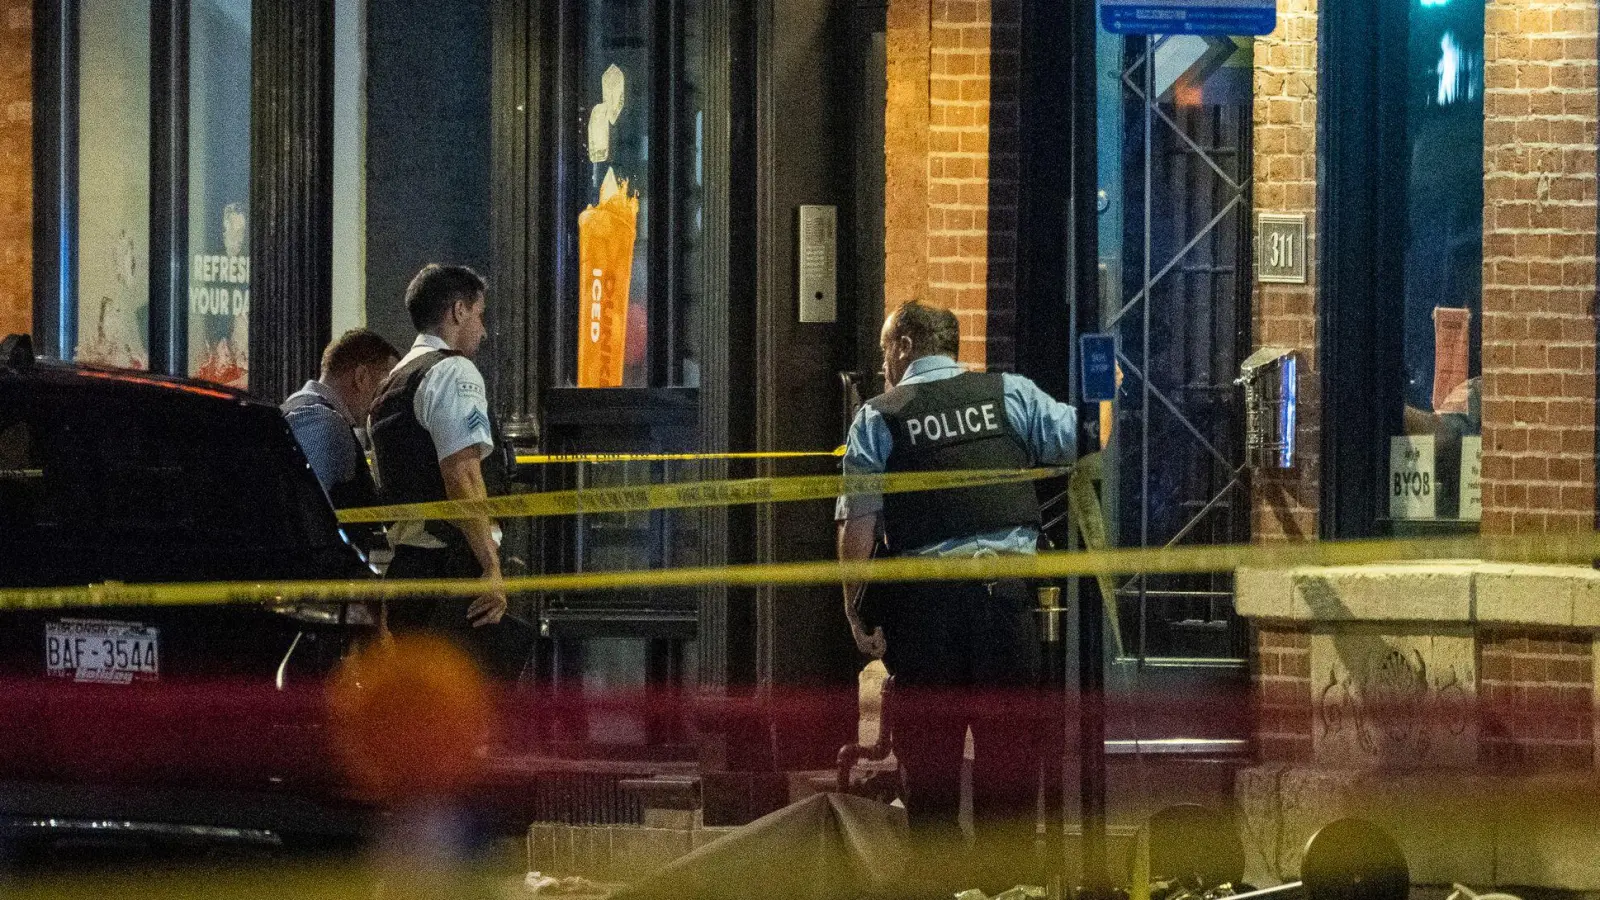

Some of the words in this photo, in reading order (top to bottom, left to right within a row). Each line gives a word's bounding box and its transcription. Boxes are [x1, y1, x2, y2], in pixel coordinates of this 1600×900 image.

[1268, 232, 1293, 267] 311
[189, 287, 229, 315] YOUR
[591, 269, 602, 343] ICED
[906, 403, 999, 446] POLICE
[1393, 471, 1431, 497] BYOB
[48, 637, 156, 670] BAF-3544
